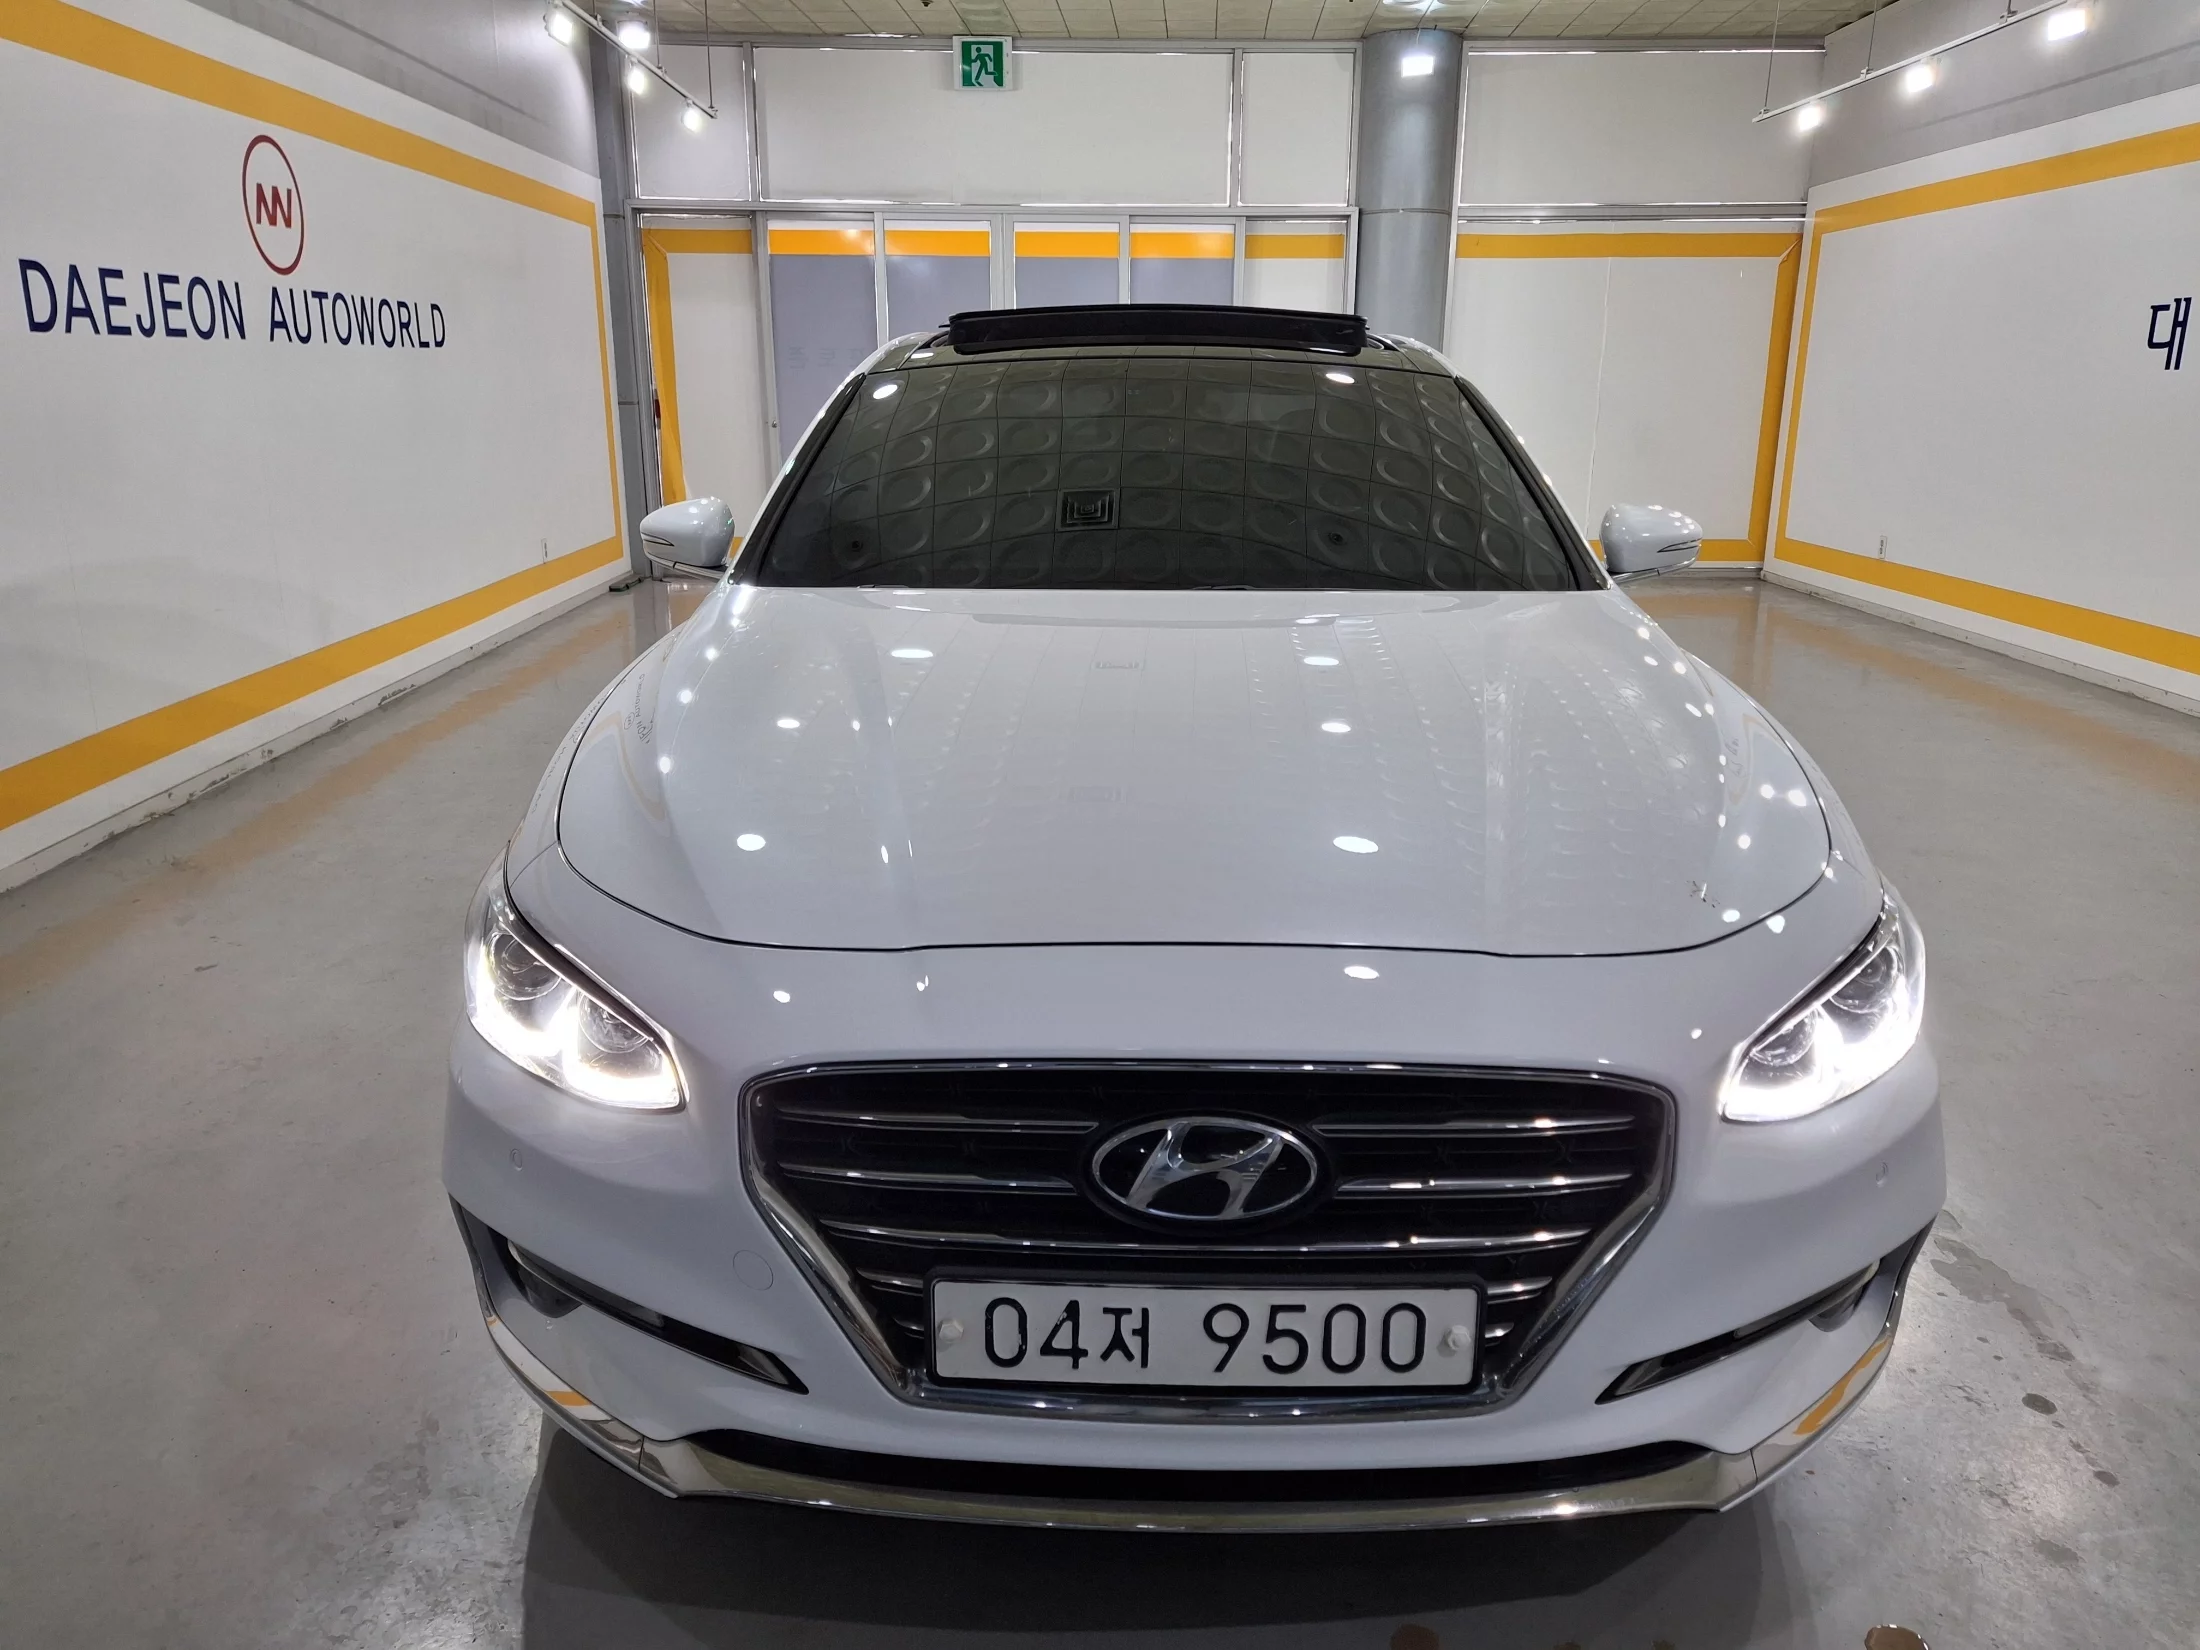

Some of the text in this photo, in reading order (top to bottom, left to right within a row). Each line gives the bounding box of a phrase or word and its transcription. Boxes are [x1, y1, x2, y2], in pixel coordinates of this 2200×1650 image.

[18, 258, 446, 349] DAEJEON AUTOWORLD
[2147, 296, 2193, 371] 대
[984, 1296, 1427, 1376] 04저 9500
